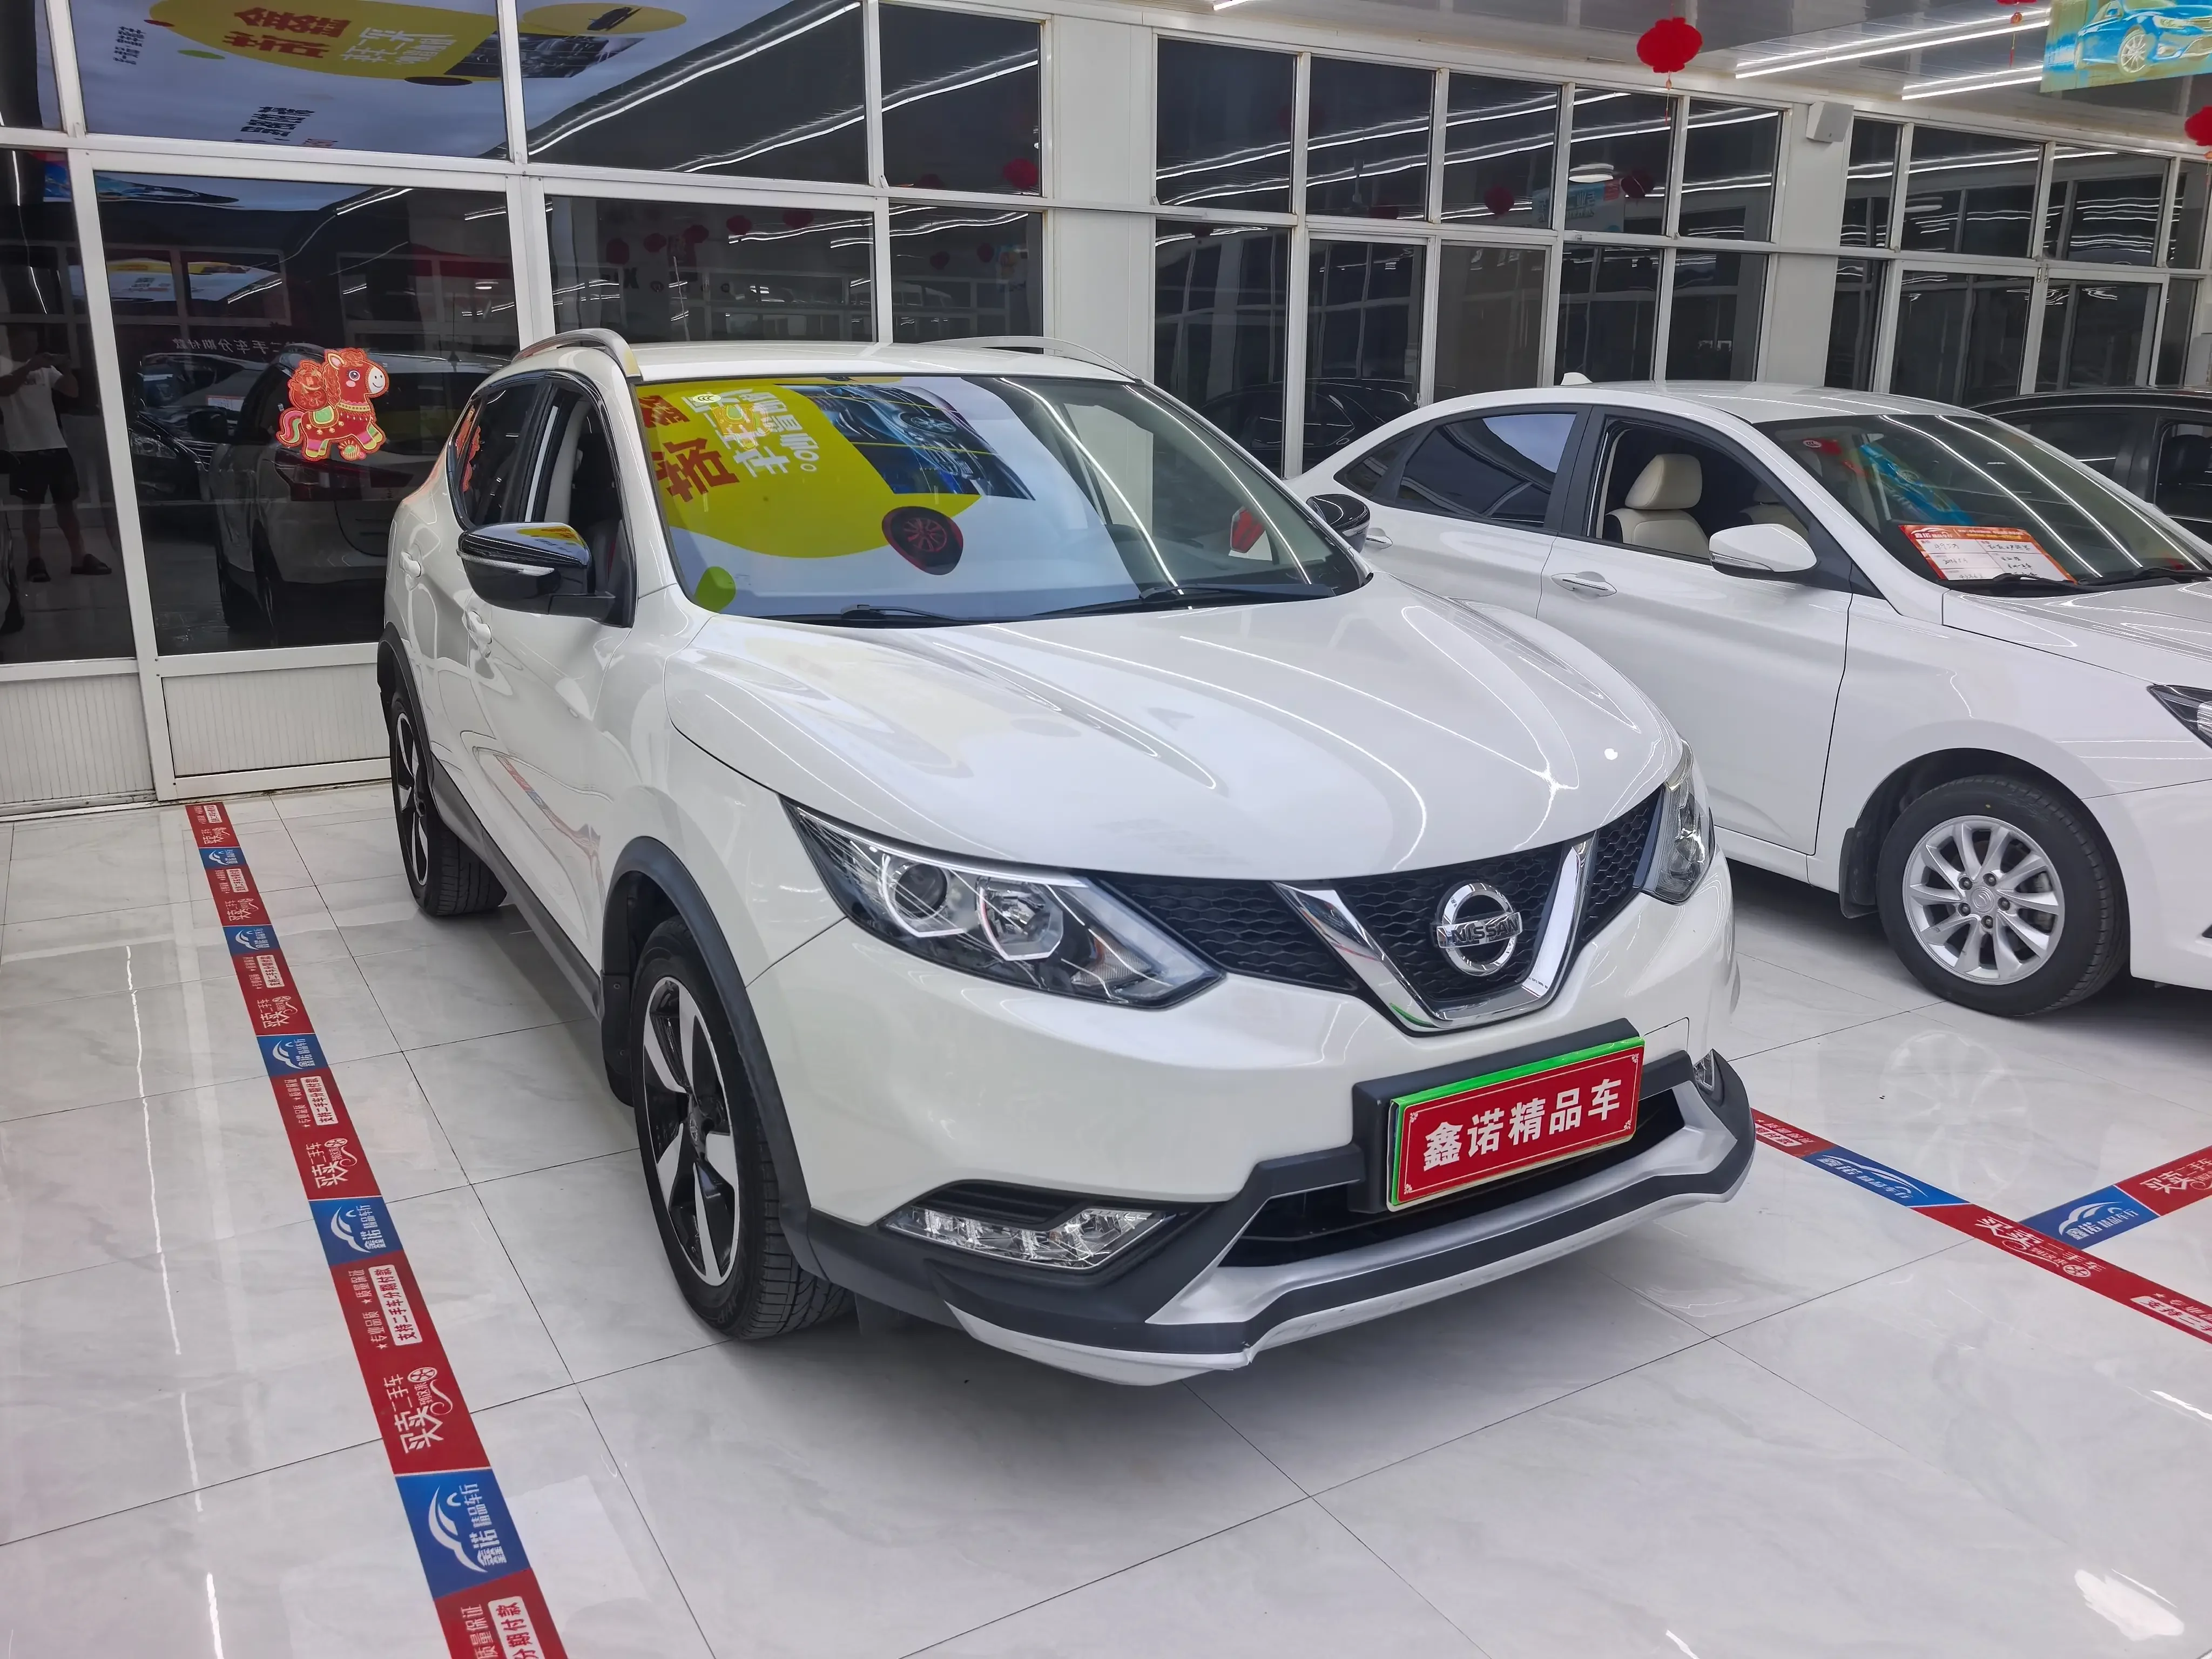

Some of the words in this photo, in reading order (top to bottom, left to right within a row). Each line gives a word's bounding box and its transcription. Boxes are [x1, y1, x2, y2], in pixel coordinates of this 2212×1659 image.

[1451, 914, 1519, 943] NISSAN
[1423, 1078, 1622, 1172] 鑫诺精品车
[306, 1142, 349, 1189] 买卖二手车
[356, 1205, 378, 1229] 精品车行
[2066, 1222, 2102, 1240] 鑫诺
[2099, 1209, 2139, 1228] 精品车行
[360, 1229, 387, 1250] 鑫诺
[348, 1269, 374, 1298] 质量保证
[375, 1267, 417, 1341] 支持二手车分期付款
[362, 1311, 387, 1344] 专业品质
[383, 1373, 444, 1454] 买卖二手车
[459, 1483, 493, 1528] 精品车行
[469, 1529, 507, 1567] 鑫诺
